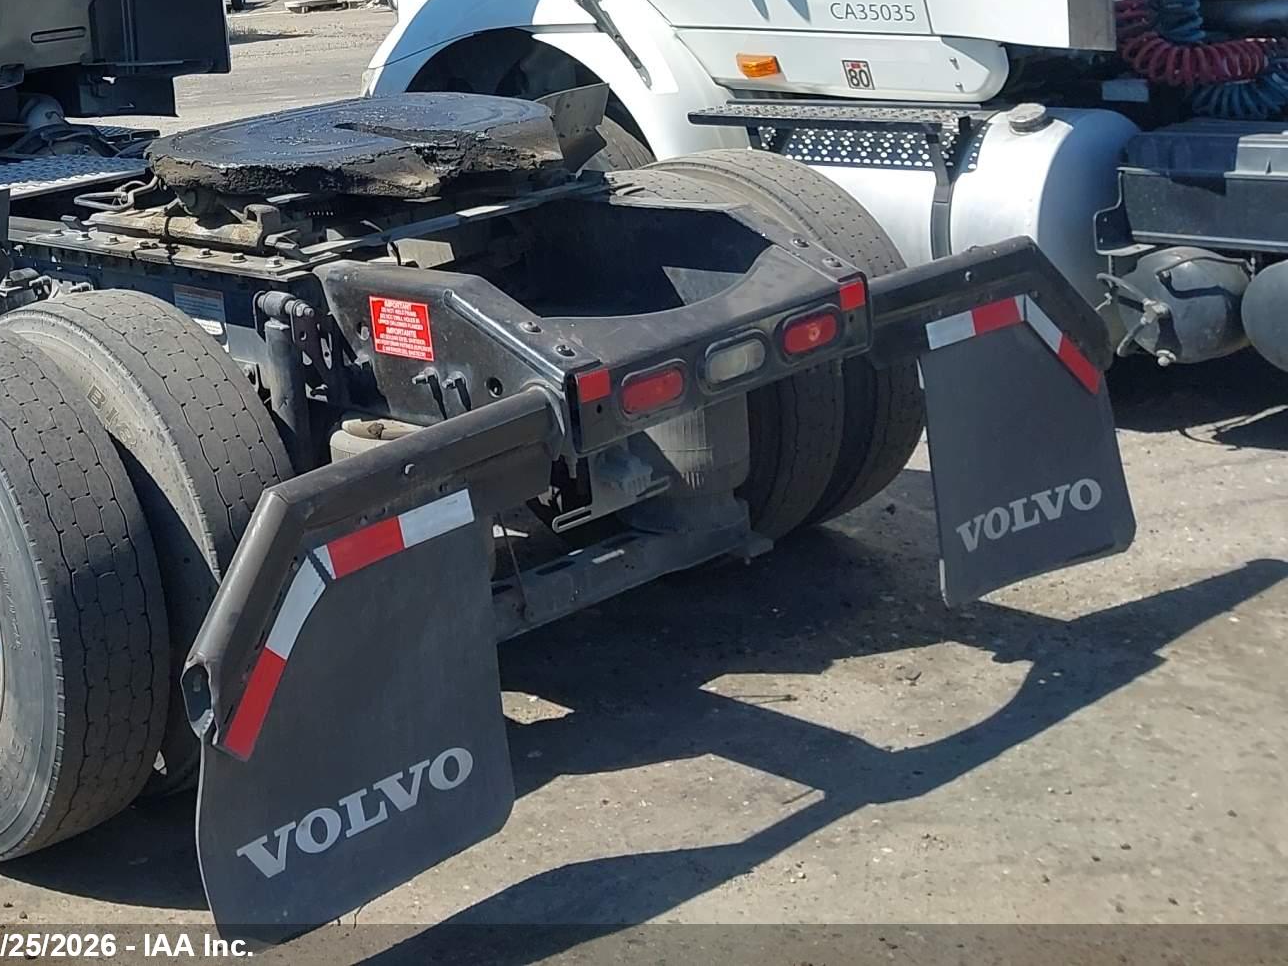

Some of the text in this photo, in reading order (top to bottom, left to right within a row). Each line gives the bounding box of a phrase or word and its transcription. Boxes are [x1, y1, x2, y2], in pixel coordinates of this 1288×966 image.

[830, 2, 916, 21] CA35035
[848, 68, 870, 87] 80
[956, 478, 1102, 552] VOLVO
[236, 747, 474, 879] VOLVO
